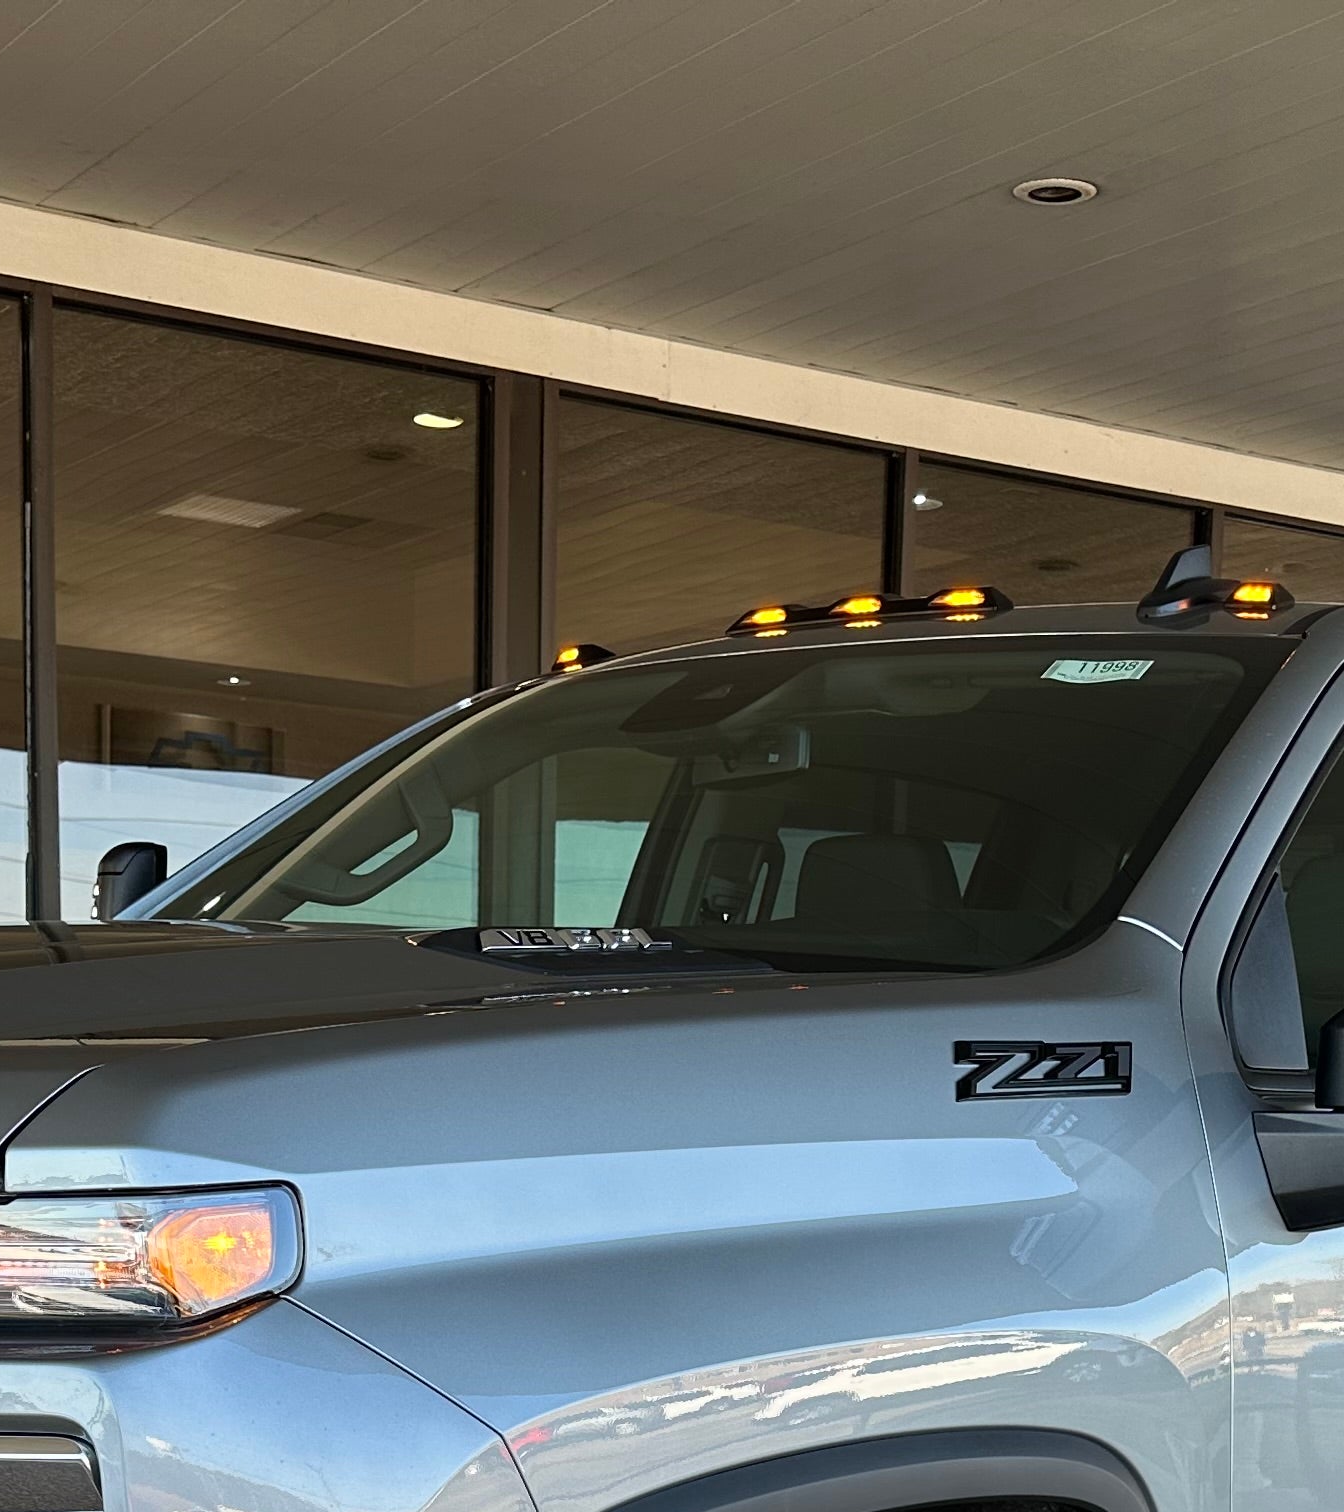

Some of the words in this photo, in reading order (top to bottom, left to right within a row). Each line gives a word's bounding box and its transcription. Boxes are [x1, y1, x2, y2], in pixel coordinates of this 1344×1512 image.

[1078, 661, 1139, 673] 11998
[496, 929, 554, 947] V8
[953, 1040, 1133, 1102] Z71
